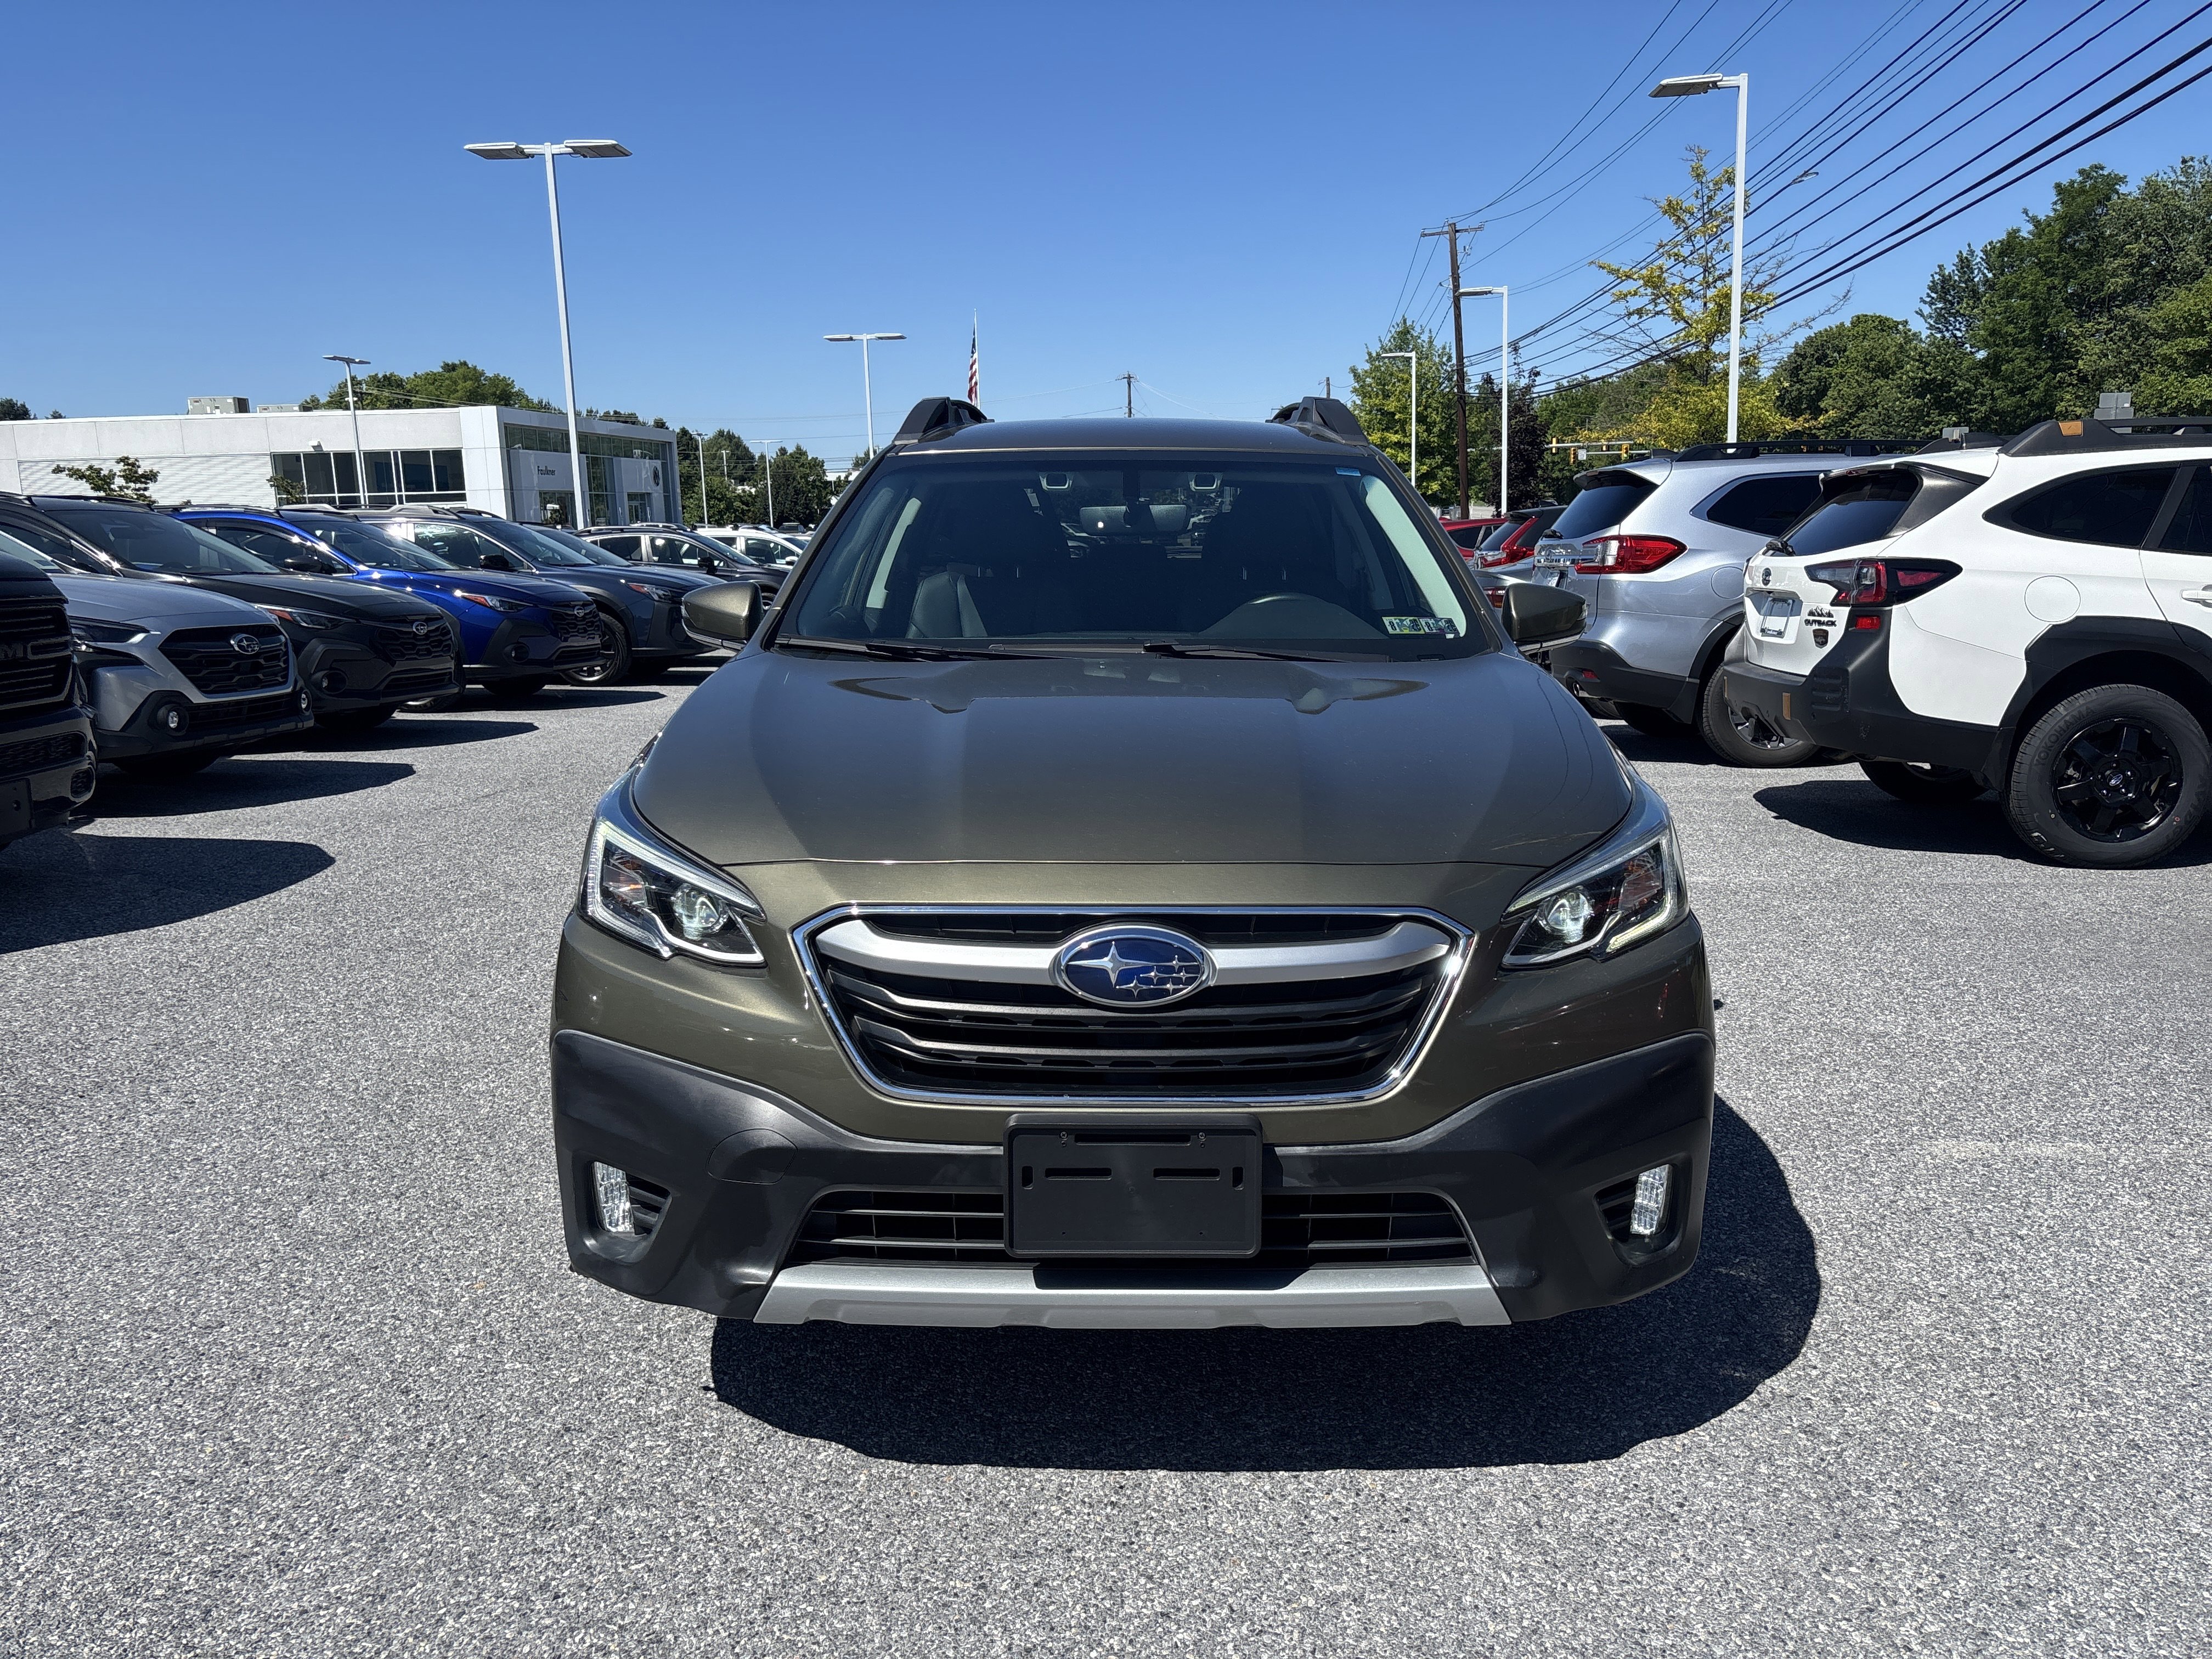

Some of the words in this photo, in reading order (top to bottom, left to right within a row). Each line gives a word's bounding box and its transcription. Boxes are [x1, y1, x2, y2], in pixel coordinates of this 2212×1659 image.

[537, 465, 556, 476] Faulkner
[1804, 618, 1837, 627] OUTBACK
[2033, 705, 2095, 766] YOKOHAMA
